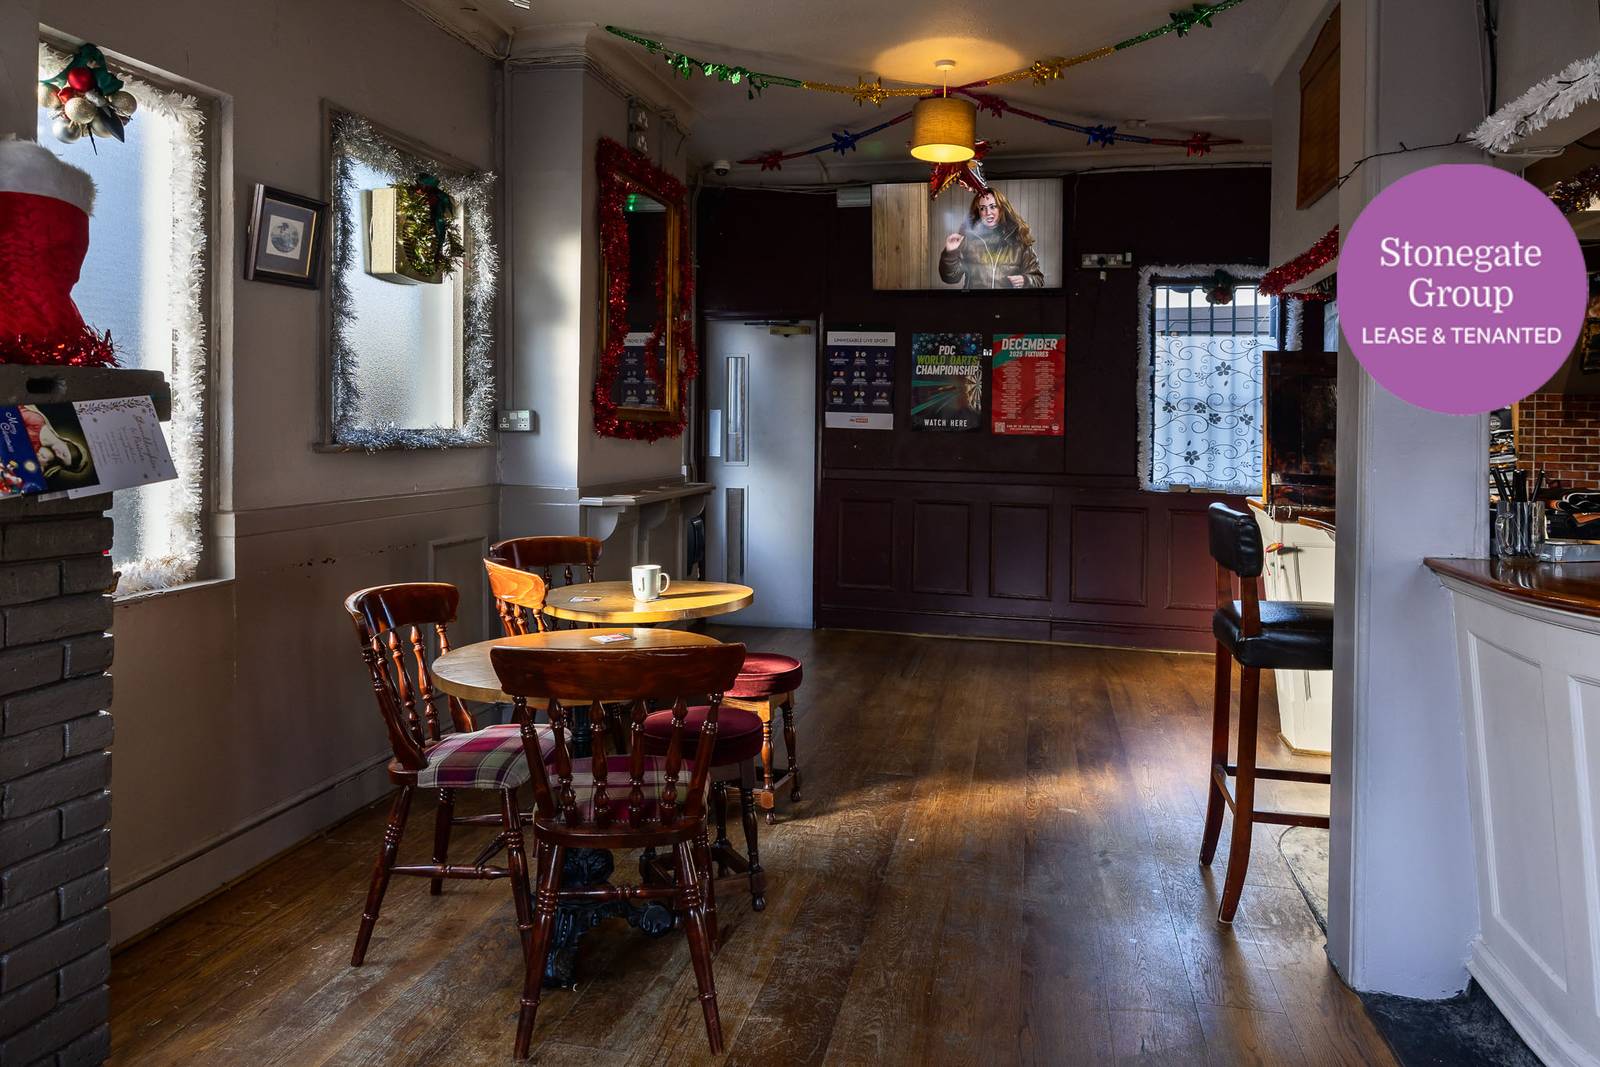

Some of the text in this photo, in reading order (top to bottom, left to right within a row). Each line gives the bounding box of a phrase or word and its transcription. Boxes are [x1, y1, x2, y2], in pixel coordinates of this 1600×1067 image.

[1001, 338, 1058, 351] DECEMBER
[938, 345, 956, 356] PDC
[916, 355, 978, 365] WORLD DARTS
[915, 364, 979, 376] CHAMPIONSHIP
[924, 418, 968, 428] WATCH HERE
